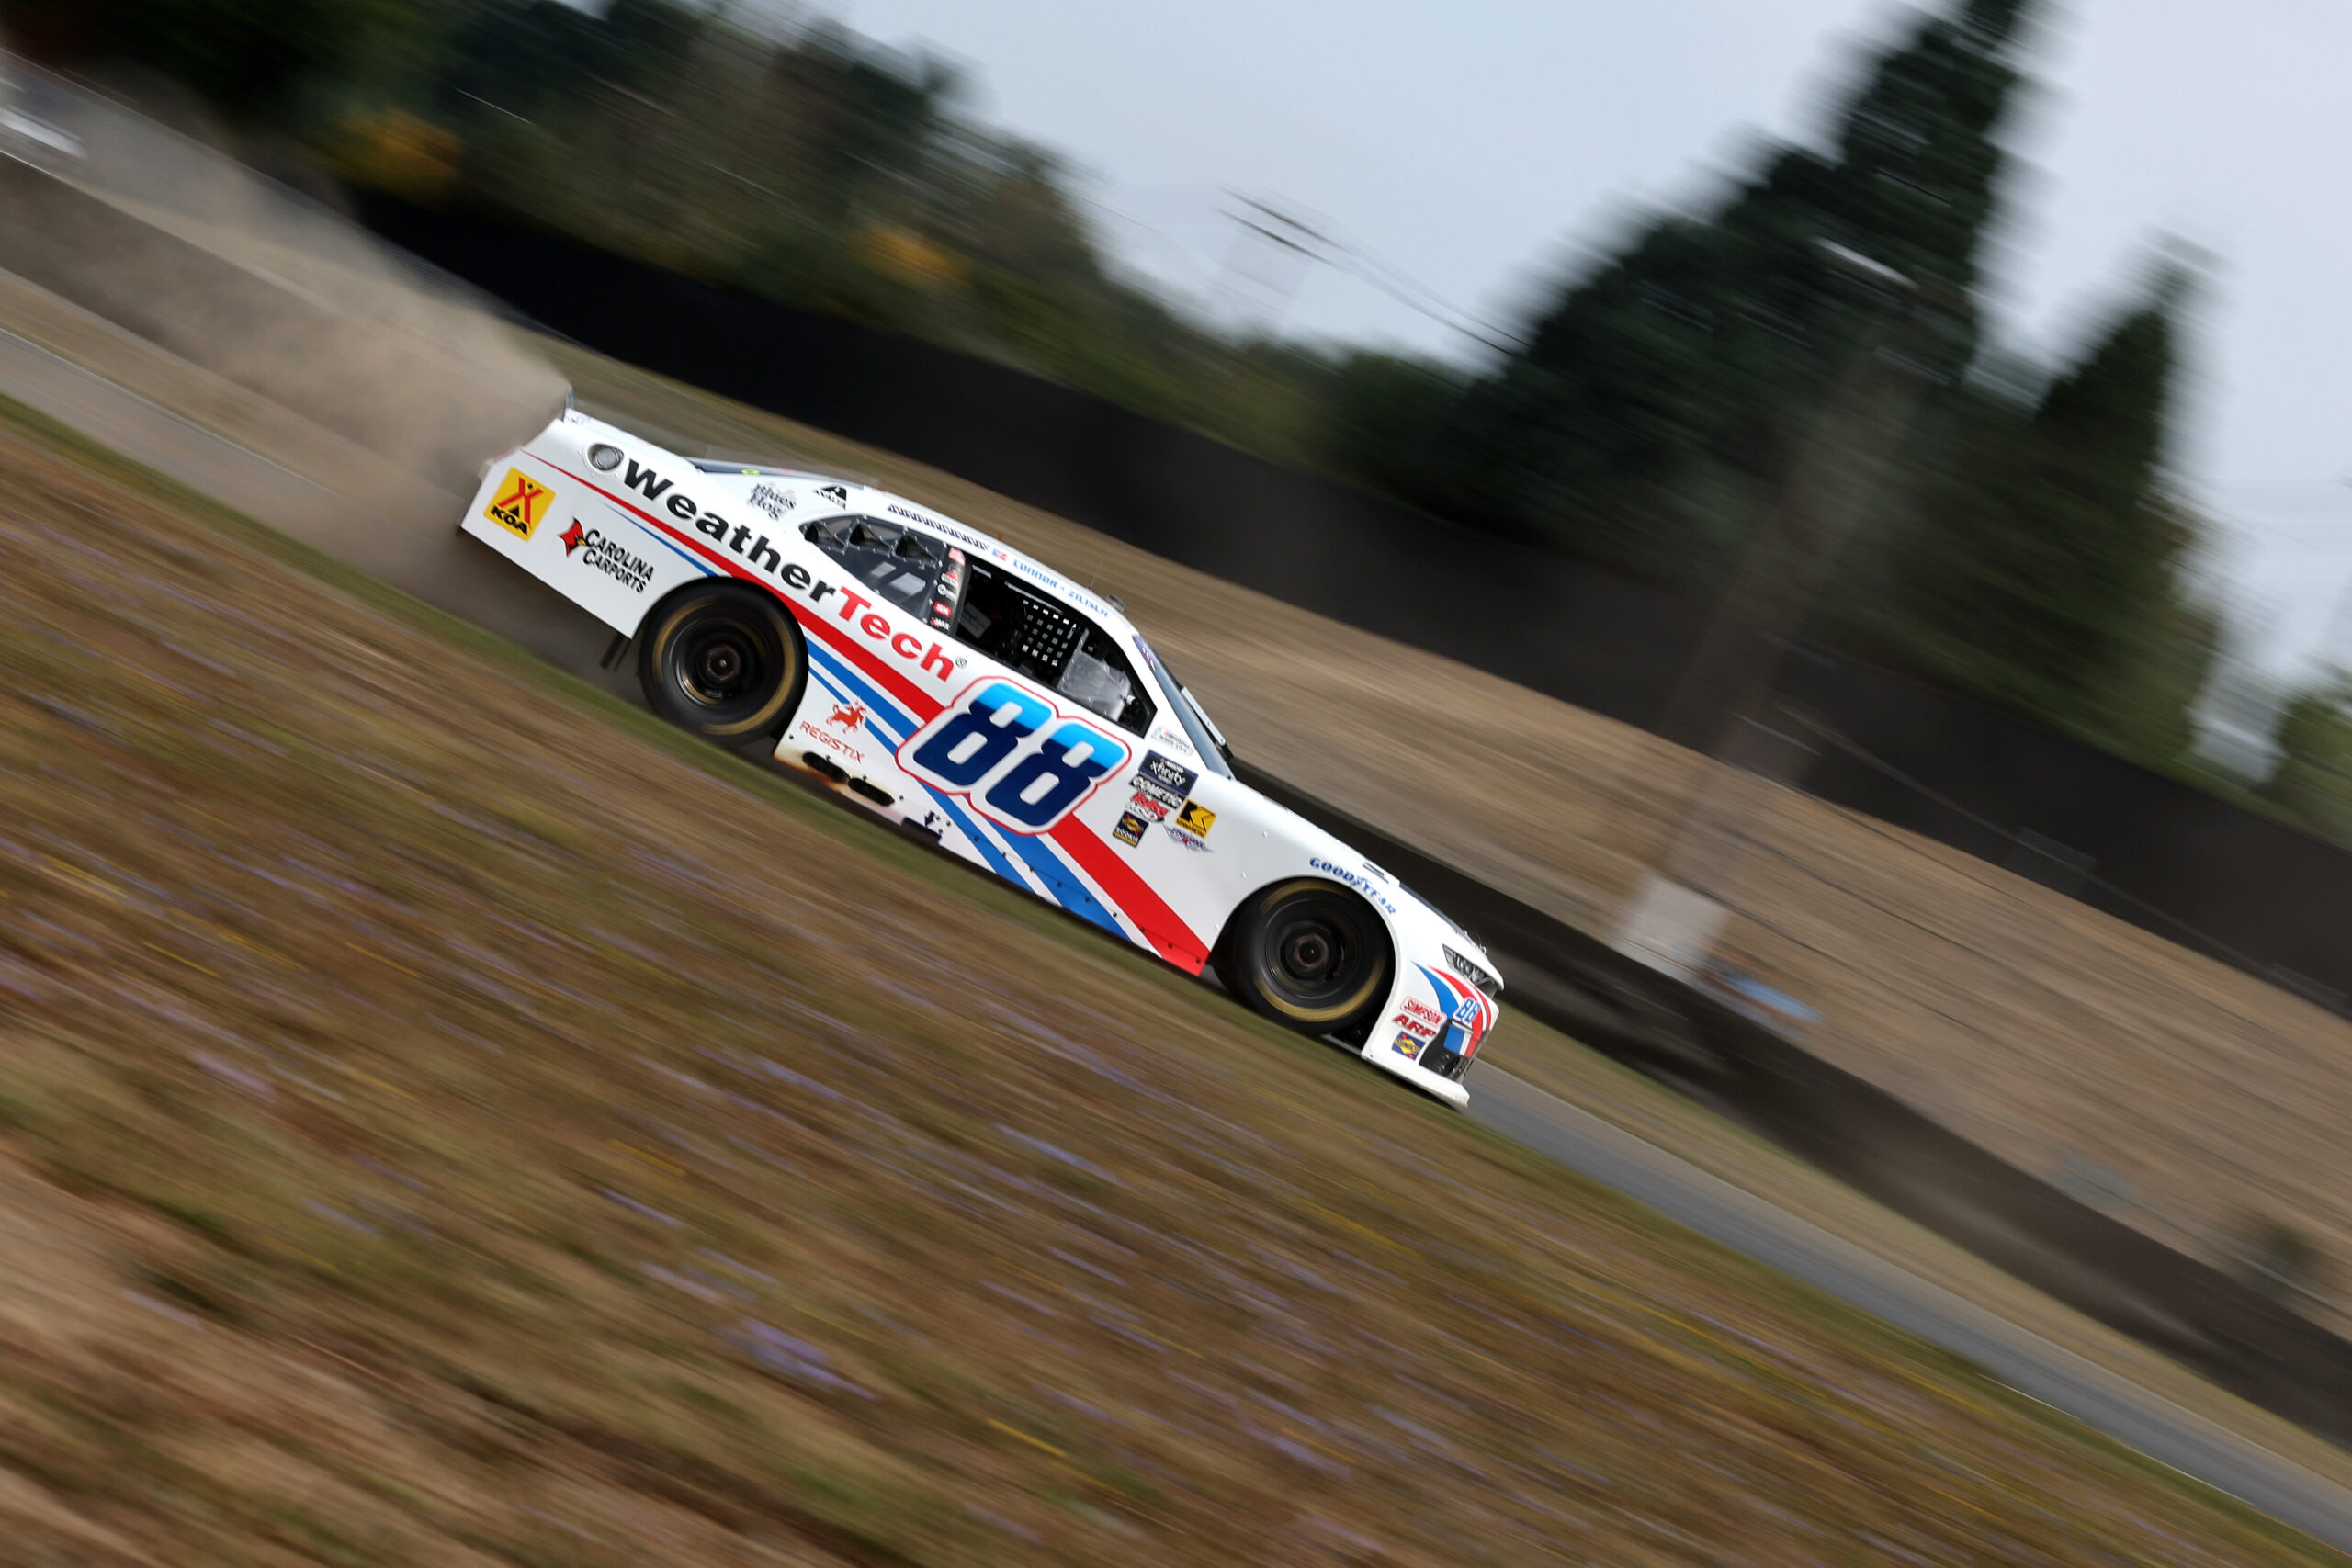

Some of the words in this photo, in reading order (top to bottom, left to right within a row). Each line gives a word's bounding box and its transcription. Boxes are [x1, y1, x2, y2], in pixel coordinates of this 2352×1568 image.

[490, 505, 528, 536] KOA
[582, 550, 647, 594] CARPORTS
[584, 529, 654, 582] CAROLINA
[799, 720, 865, 764] REGISTIX
[910, 680, 1126, 829] 88
[1309, 857, 1396, 915] GOODYEAR
[1392, 1013, 1437, 1038] ARP
[1404, 998, 1443, 1025] SIMPSON
[1456, 998, 1480, 1023] 88
